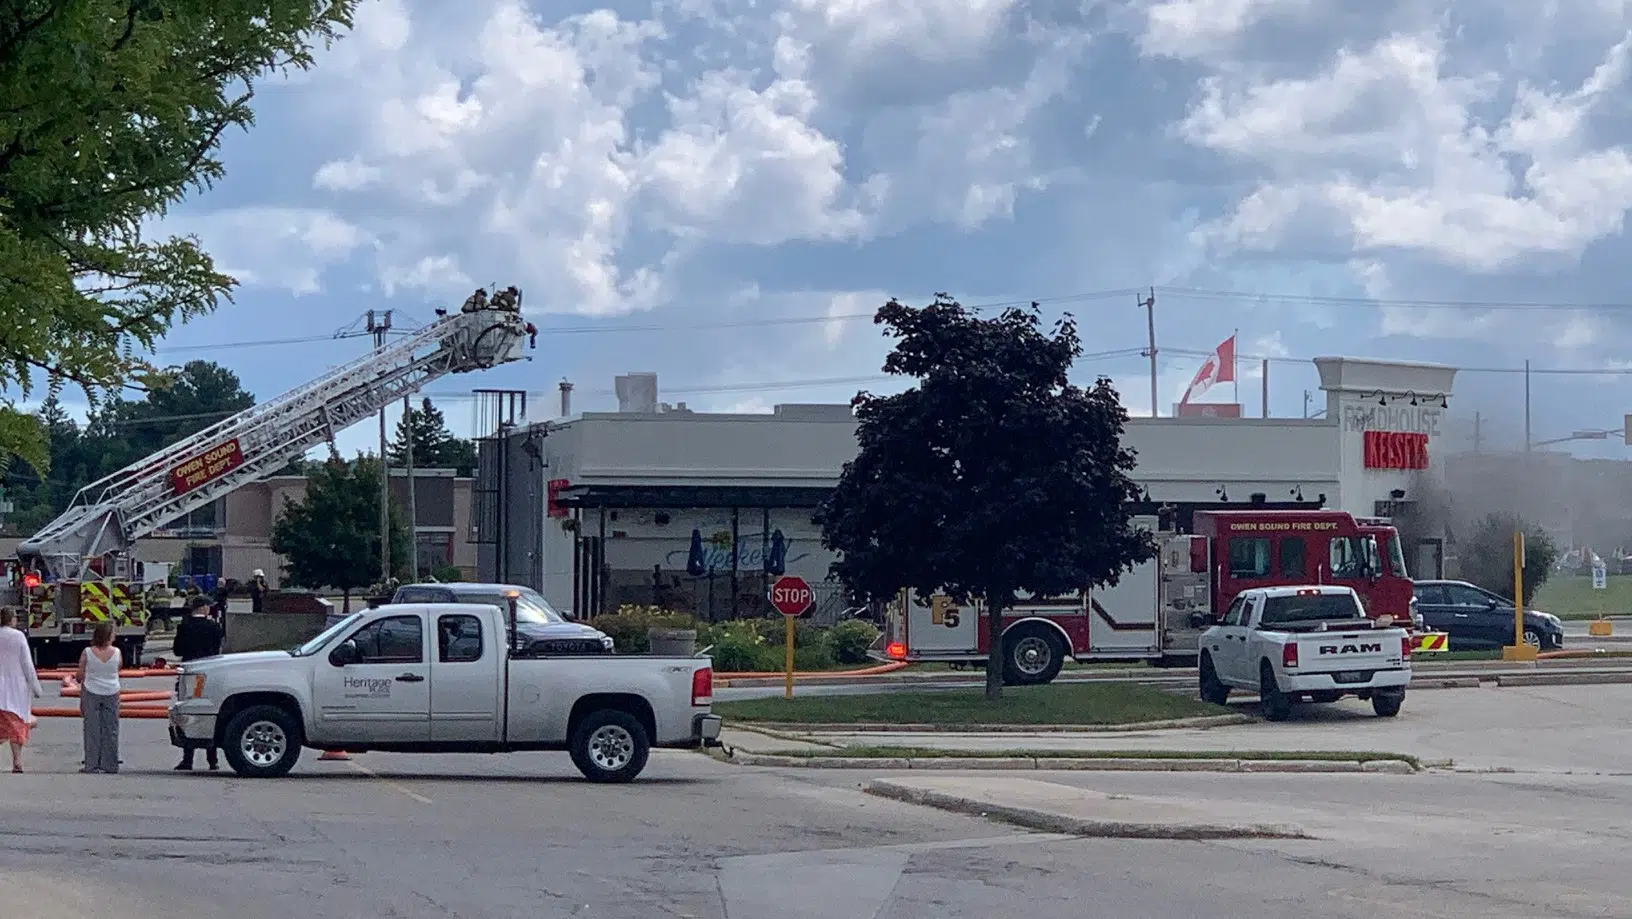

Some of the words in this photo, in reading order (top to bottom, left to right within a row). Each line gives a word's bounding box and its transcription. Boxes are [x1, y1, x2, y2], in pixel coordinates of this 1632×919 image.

[176, 457, 204, 478] OWEN
[204, 442, 237, 464] SOUND
[186, 468, 208, 486] FIRE
[1230, 522, 1257, 531] OWEN
[1259, 522, 1290, 531] SOUND
[1292, 522, 1312, 531] FIRE
[1314, 521, 1339, 530] DEPT.
[774, 588, 809, 604] STOP
[1319, 643, 1382, 655] RAM
[344, 676, 392, 692] Heritage
